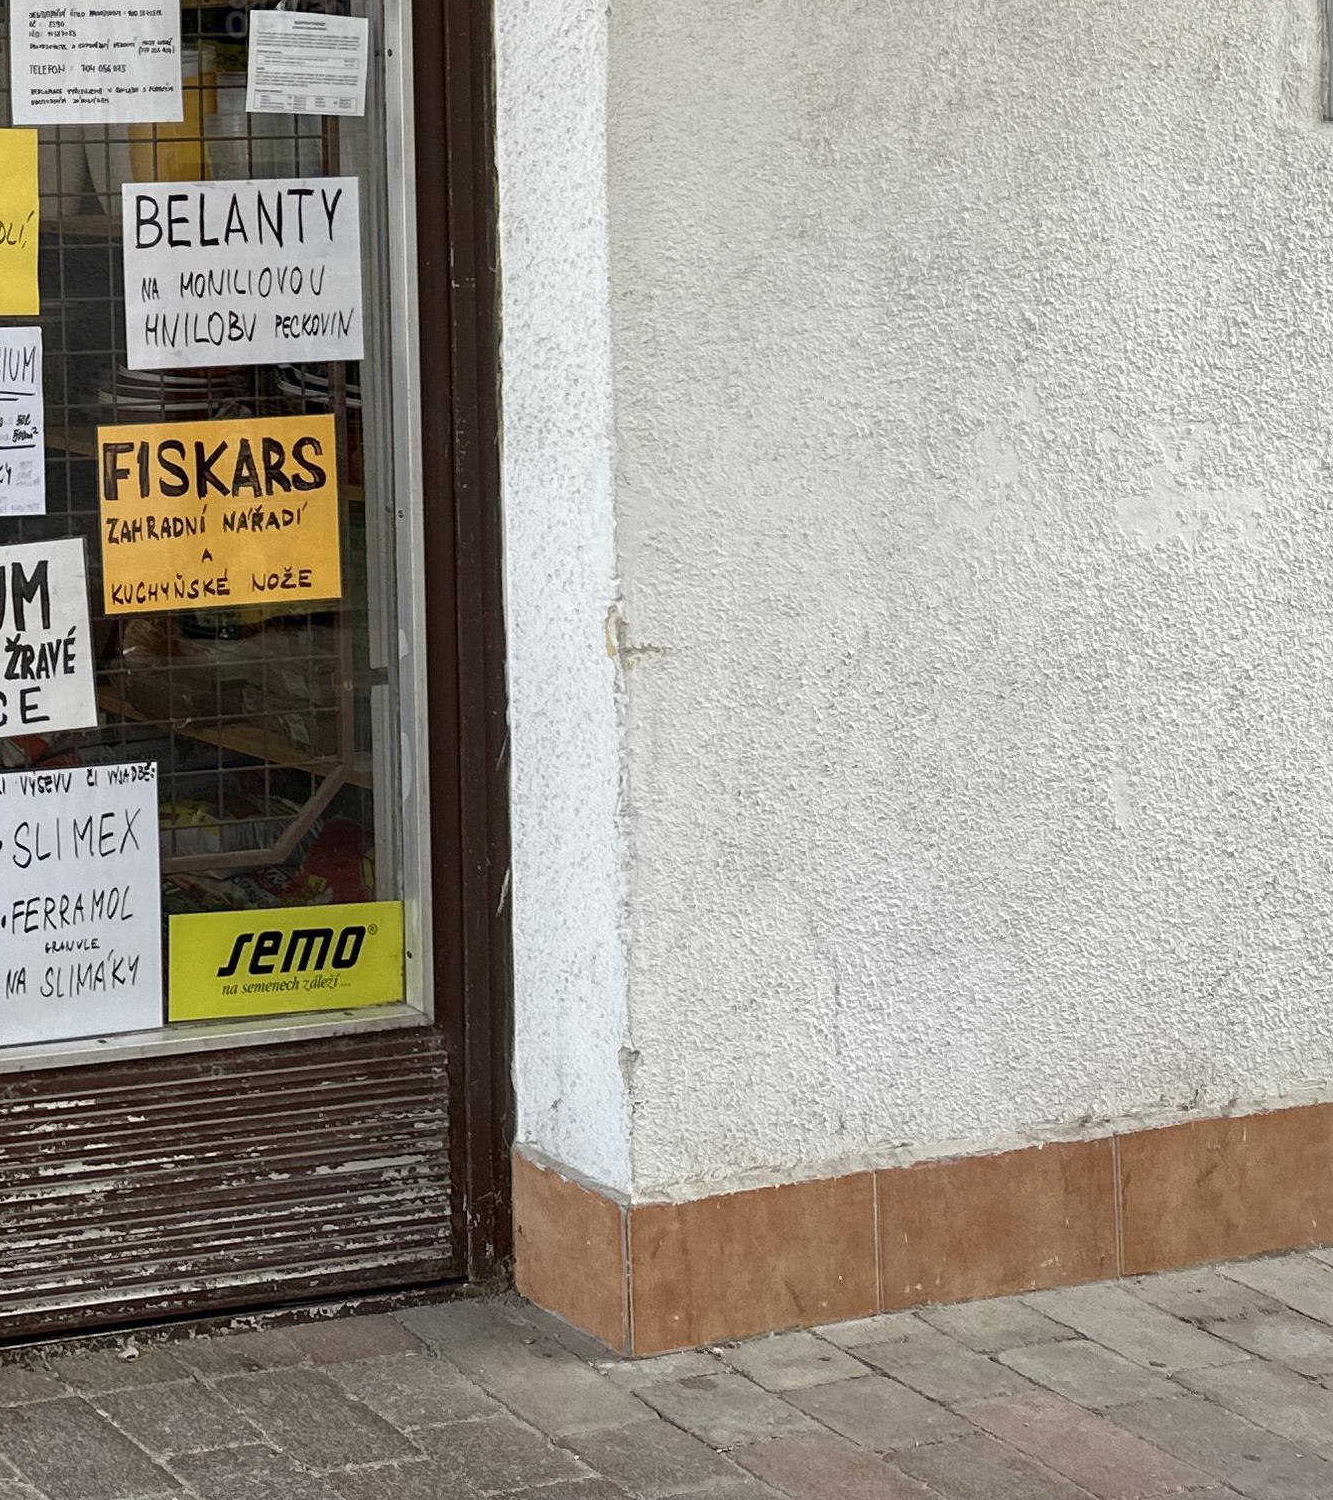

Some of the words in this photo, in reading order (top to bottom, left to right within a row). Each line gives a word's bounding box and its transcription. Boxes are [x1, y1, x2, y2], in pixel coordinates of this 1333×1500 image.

[29, 64, 65, 75] TELEFON
[134, 188, 343, 250] BELANTY
[141, 277, 160, 301] NA
[180, 265, 326, 299] MONILIOVOU
[275, 308, 355, 340] PECKOVIN
[102, 436, 327, 500] FISKARS
[105, 504, 208, 545] ZAHRADNÍ
[222, 501, 308, 534] NÁŘADÍ
[201, 547, 213, 564] A
[110, 568, 231, 606] KUCHYŇSKÉ
[251, 568, 313, 592] NOŽE
[4, 626, 76, 680] ŽRAVÉ
[87, 768, 98, 787] ČI
[12, 808, 143, 870] SLIMEX
[11, 885, 134, 935] FERRAMOL
[5, 967, 28, 997] NA
[39, 951, 141, 998] SLIMÁKY
[222, 984, 238, 995] na
[241, 977, 299, 994] semenech
